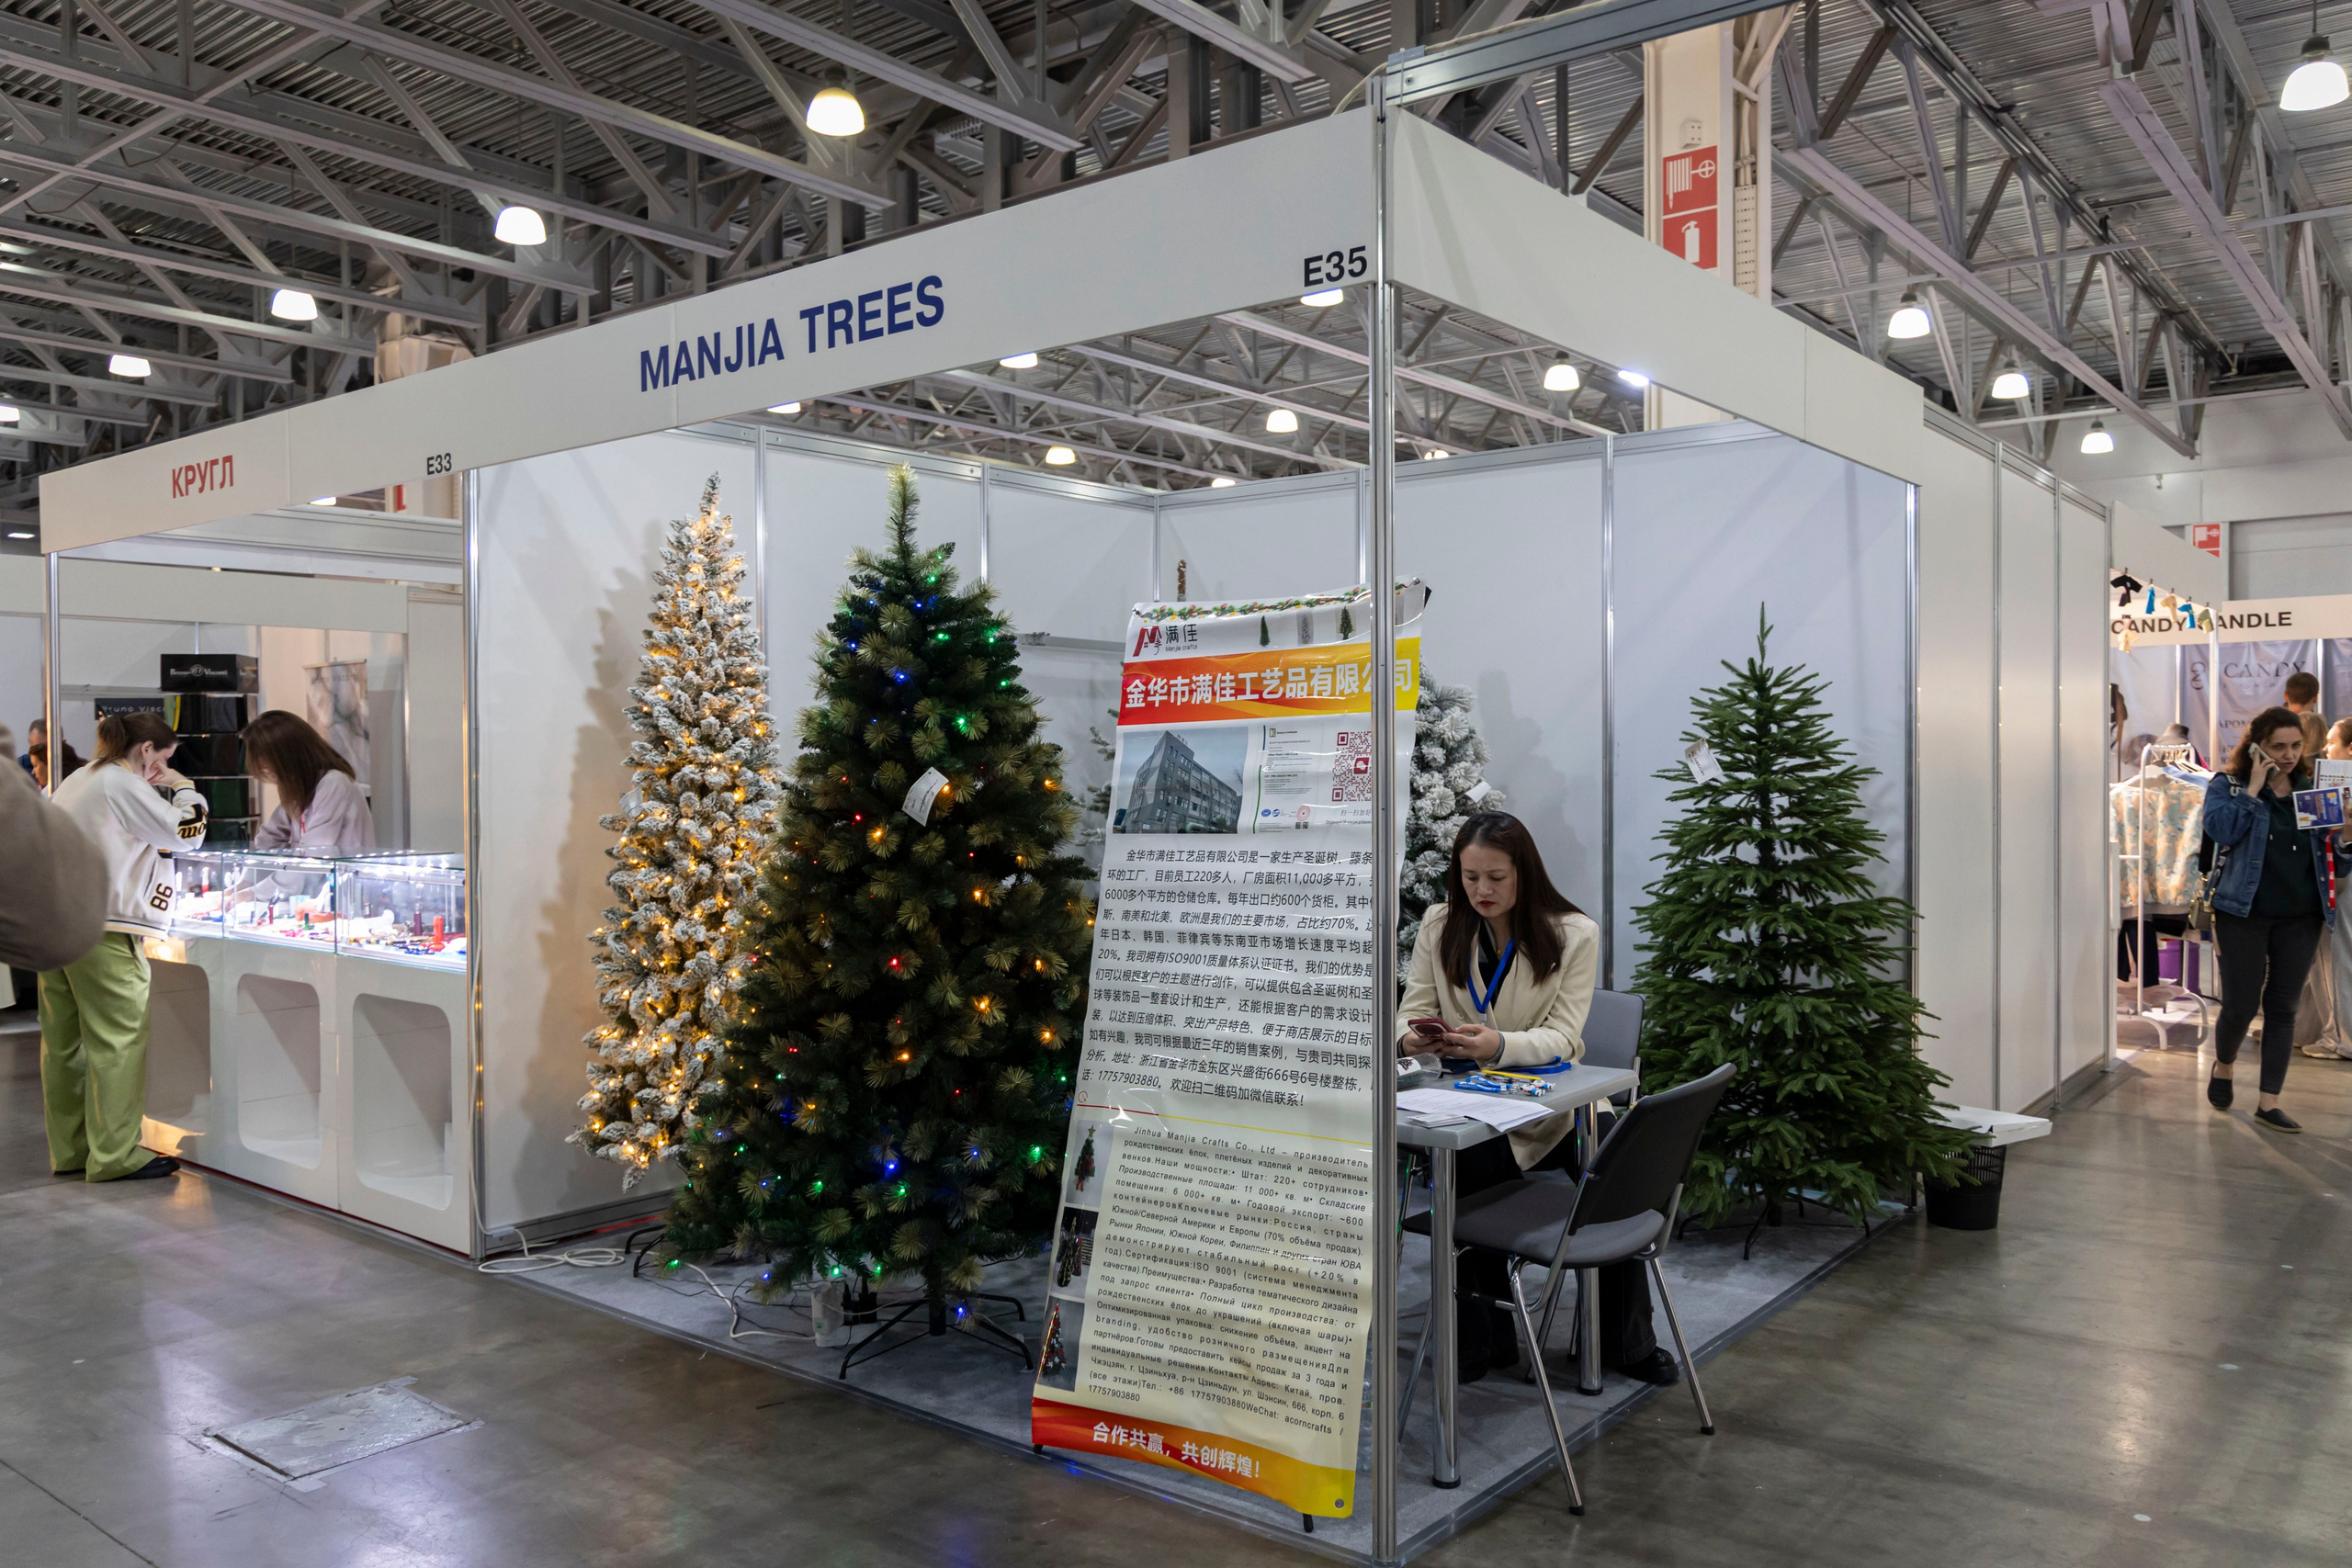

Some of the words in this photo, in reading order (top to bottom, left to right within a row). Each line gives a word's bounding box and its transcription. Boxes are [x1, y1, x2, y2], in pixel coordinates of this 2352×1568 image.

[1304, 245, 1367, 288] E35
[640, 318, 785, 392] MANJIA
[799, 275, 944, 354] TREES
[172, 455, 234, 499] КРУГЛ
[426, 452, 452, 475] E33
[1165, 624, 1198, 644] 满佳
[2111, 617, 2188, 635] CANDY
[2198, 612, 2292, 631] ANDLE
[1182, 643, 1198, 651] crafts
[2224, 661, 2305, 678] CANDY
[150, 883, 173, 911] 86
[1124, 1140, 1183, 1155] рождественских
[1189, 1148, 1209, 1159] ёлок,
[1215, 1154, 1252, 1165] плетёных
[1258, 1160, 1292, 1170] изделий
[1307, 1168, 1368, 1182] декоративных
[1134, 1127, 1161, 1138] Jinhua
[1167, 1131, 1195, 1144] Manjia
[1202, 1136, 1229, 1148] Crafts
[1235, 1141, 1254, 1153] Co.,
[1261, 1145, 1275, 1155] Ltd
[1294, 1151, 1368, 1168] производитель
[1122, 1153, 1178, 1168] венков.Наши
[1241, 1170, 1267, 1181] Штат:
[1273, 1175, 1295, 1185] 220+
[1115, 1179, 1167, 1193] помещения:
[1173, 1187, 1179, 1195] 6
[1183, 1189, 1204, 1199] 000+
[1211, 1195, 1224, 1203] кв.
[1247, 1200, 1285, 1213] Годовой
[1292, 1209, 1332, 1222] экспорт:
[1340, 1216, 1363, 1226] ~600
[1198, 1179, 1238, 1191] площади:
[1245, 1185, 1252, 1193] 11
[1259, 1187, 1279, 1197] 000+
[1318, 1197, 1366, 1212] Складские
[1109, 1218, 1133, 1229] Рынки
[1135, 1223, 1166, 1236] Японии,
[1169, 1229, 1197, 1241] Южной
[1199, 1235, 1226, 1247] Кореи,
[1229, 1240, 1271, 1254] Филиппин
[1340, 1258, 1362, 1270] ЮВА
[1112, 1204, 1178, 1224] Южной/Северной
[1182, 1217, 1216, 1230] Америки
[1229, 1224, 1260, 1237] Европы
[1264, 1231, 1284, 1242] (70%
[1289, 1235, 1321, 1248] объёма
[1326, 1243, 1363, 1257] продаж).
[1237, 1213, 1316, 1234] рынки:Россия,
[1323, 1228, 1363, 1241] страны
[1105, 1233, 1190, 1254] демонстрируют
[1197, 1250, 1265, 1269] стабильный
[1273, 1264, 1300, 1274] рост
[1307, 1269, 1344, 1282] (+20%
[1100, 1274, 1115, 1284] под
[1120, 1279, 1149, 1290] запрос
[1200, 1292, 1235, 1305] Полный
[1241, 1302, 1263, 1312] цикл
[1269, 1307, 1338, 1325] производства:
[1344, 1321, 1355, 1329] от
[1208, 1279, 1255, 1295] Разработка
[1258, 1290, 1319, 1307] тематического
[1321, 1302, 1358, 1314] дизайна
[1216, 1265, 1236, 1277] 9001
[1243, 1270, 1285, 1286] (система
[1293, 1281, 1358, 1300] менеджмента
[1097, 1288, 1165, 1307] рождественских
[1170, 1302, 1191, 1312] ёлок
[1195, 1307, 1207, 1315] до
[1213, 1311, 1261, 1325] украшений
[1268, 1320, 1311, 1336] (включая
[1096, 1314, 1140, 1331] branding,
[1148, 1325, 1193, 1340] удобство
[1200, 1336, 1255, 1354] розничного
[1262, 1350, 1349, 1375] размещенияДля
[1176, 1317, 1215, 1330] упаковка:
[1220, 1325, 1259, 1340] снижение
[1264, 1335, 1298, 1349] объёма,
[1304, 1344, 1333, 1356] акцент
[1340, 1351, 1351, 1359] на
[1091, 1344, 1161, 1363] индивидуальные
[1284, 1384, 1312, 1399] Китай,
[1319, 1394, 1345, 1405] пров.
[1169, 1345, 1225, 1361] предоставить
[1229, 1357, 1251, 1369] кейсы
[1256, 1364, 1287, 1376] продаж
[1291, 1371, 1301, 1380] за
[1306, 1373, 1311, 1382] 3
[1316, 1378, 1336, 1388] года
[1089, 1384, 1140, 1402] 17757903880
[1090, 1371, 1107, 1381] (все
[1113, 1376, 1161, 1392] этажи)Тел.:
[1169, 1386, 1184, 1395] +86
[1284, 1416, 1332, 1434] acorncrafts
[1091, 1356, 1126, 1371] Чжэцзян,
[1138, 1365, 1179, 1381] Цзиньхуа,
[1182, 1375, 1195, 1383] р-н
[1198, 1377, 1239, 1394] Цзиньдун,
[1242, 1389, 1254, 1397] ул.
[1257, 1391, 1289, 1408] Шэнсин,
[1292, 1400, 1308, 1414] 666,
[1311, 1408, 1334, 1419] корп.
[1339, 1412, 1344, 1421] 6
[1092, 1421, 1260, 1479] 合作共赢，共创辉煌！
